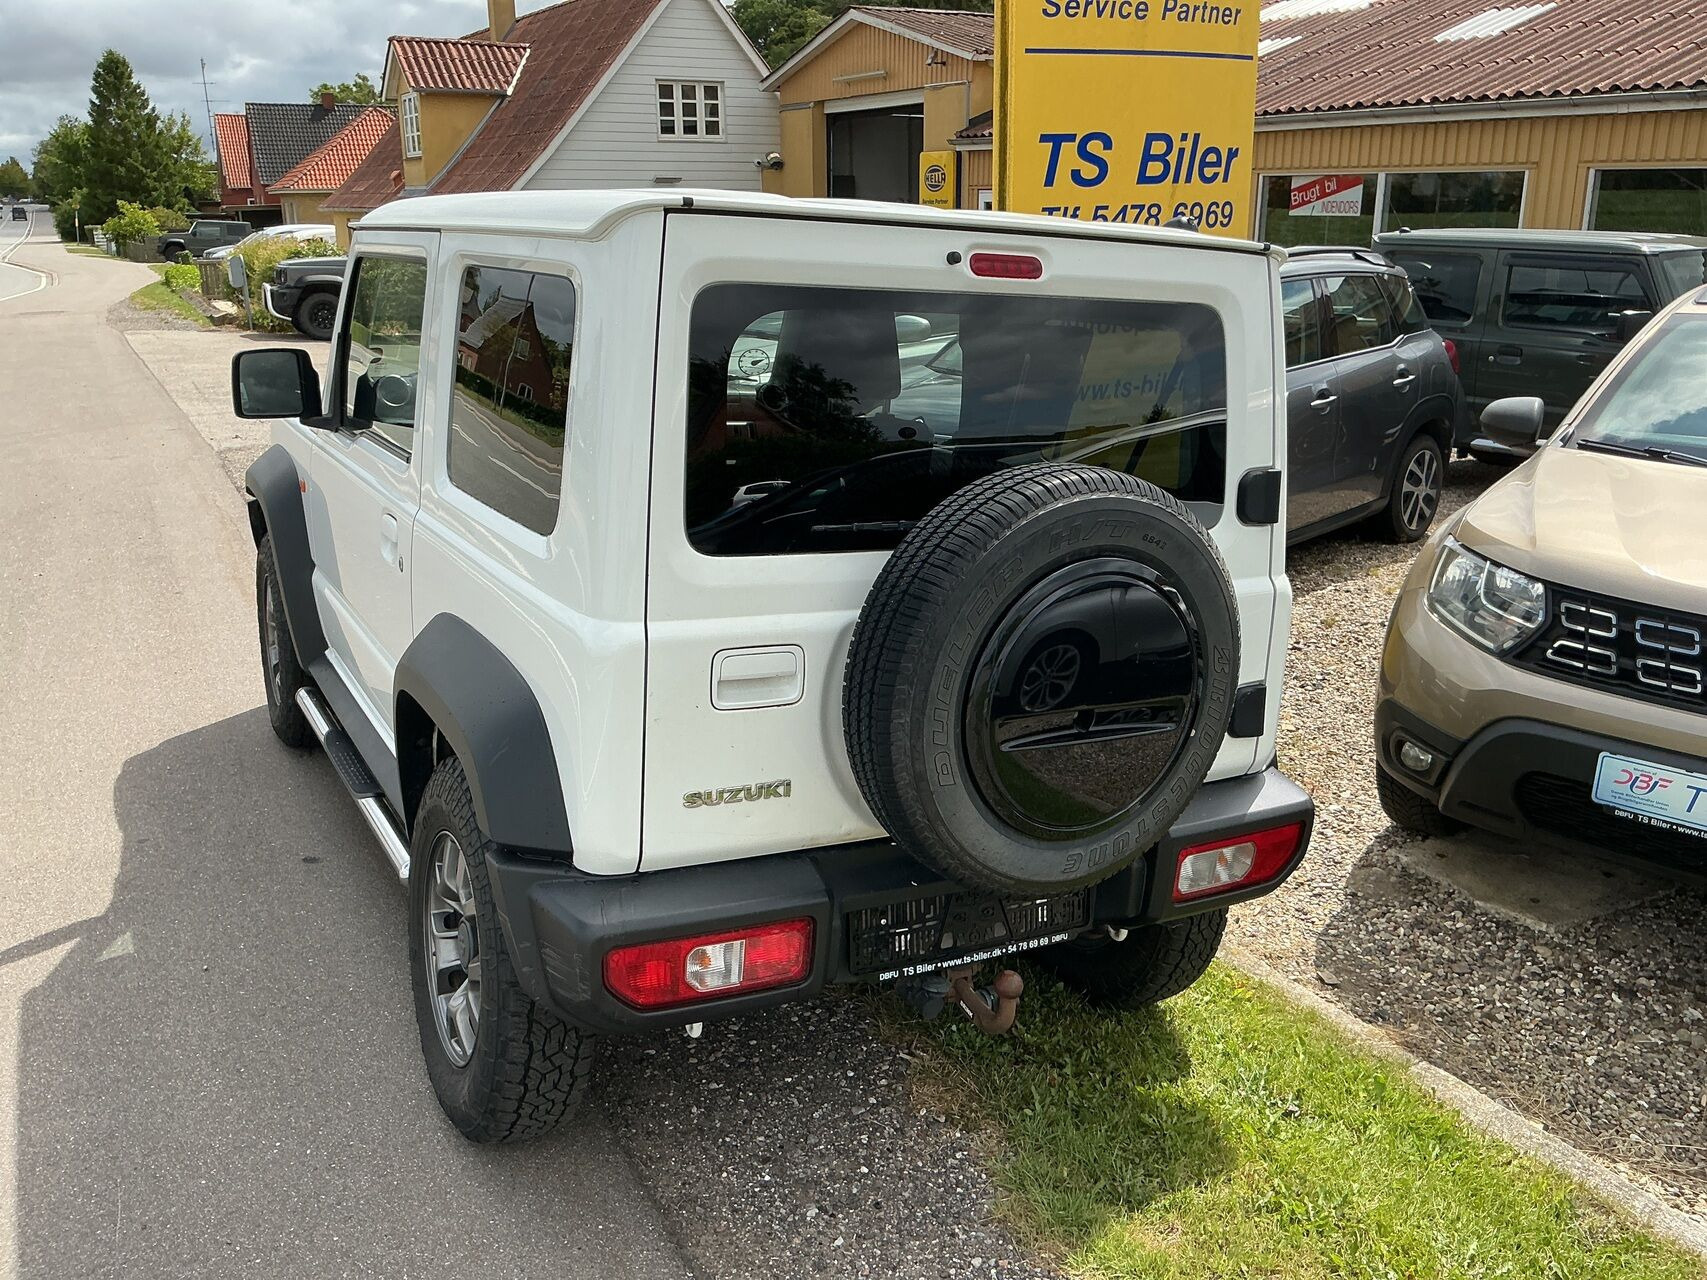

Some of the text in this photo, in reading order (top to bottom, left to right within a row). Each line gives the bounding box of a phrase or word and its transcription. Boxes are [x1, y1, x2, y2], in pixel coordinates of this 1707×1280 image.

[1041, 0, 1241, 26] Service Partner
[1039, 131, 1239, 188] TS Biler
[1290, 177, 1337, 206] Brugt bil
[1092, 202, 1162, 227] 5478
[1173, 201, 1234, 229] 6969
[682, 779, 792, 809] SUZUKI
[1637, 814, 1649, 823] TS
[1651, 818, 1672, 829] Biler
[879, 933, 1069, 981] DBFU TS Biler www.ts-biler.dk 54 78 69 69 DBFU
